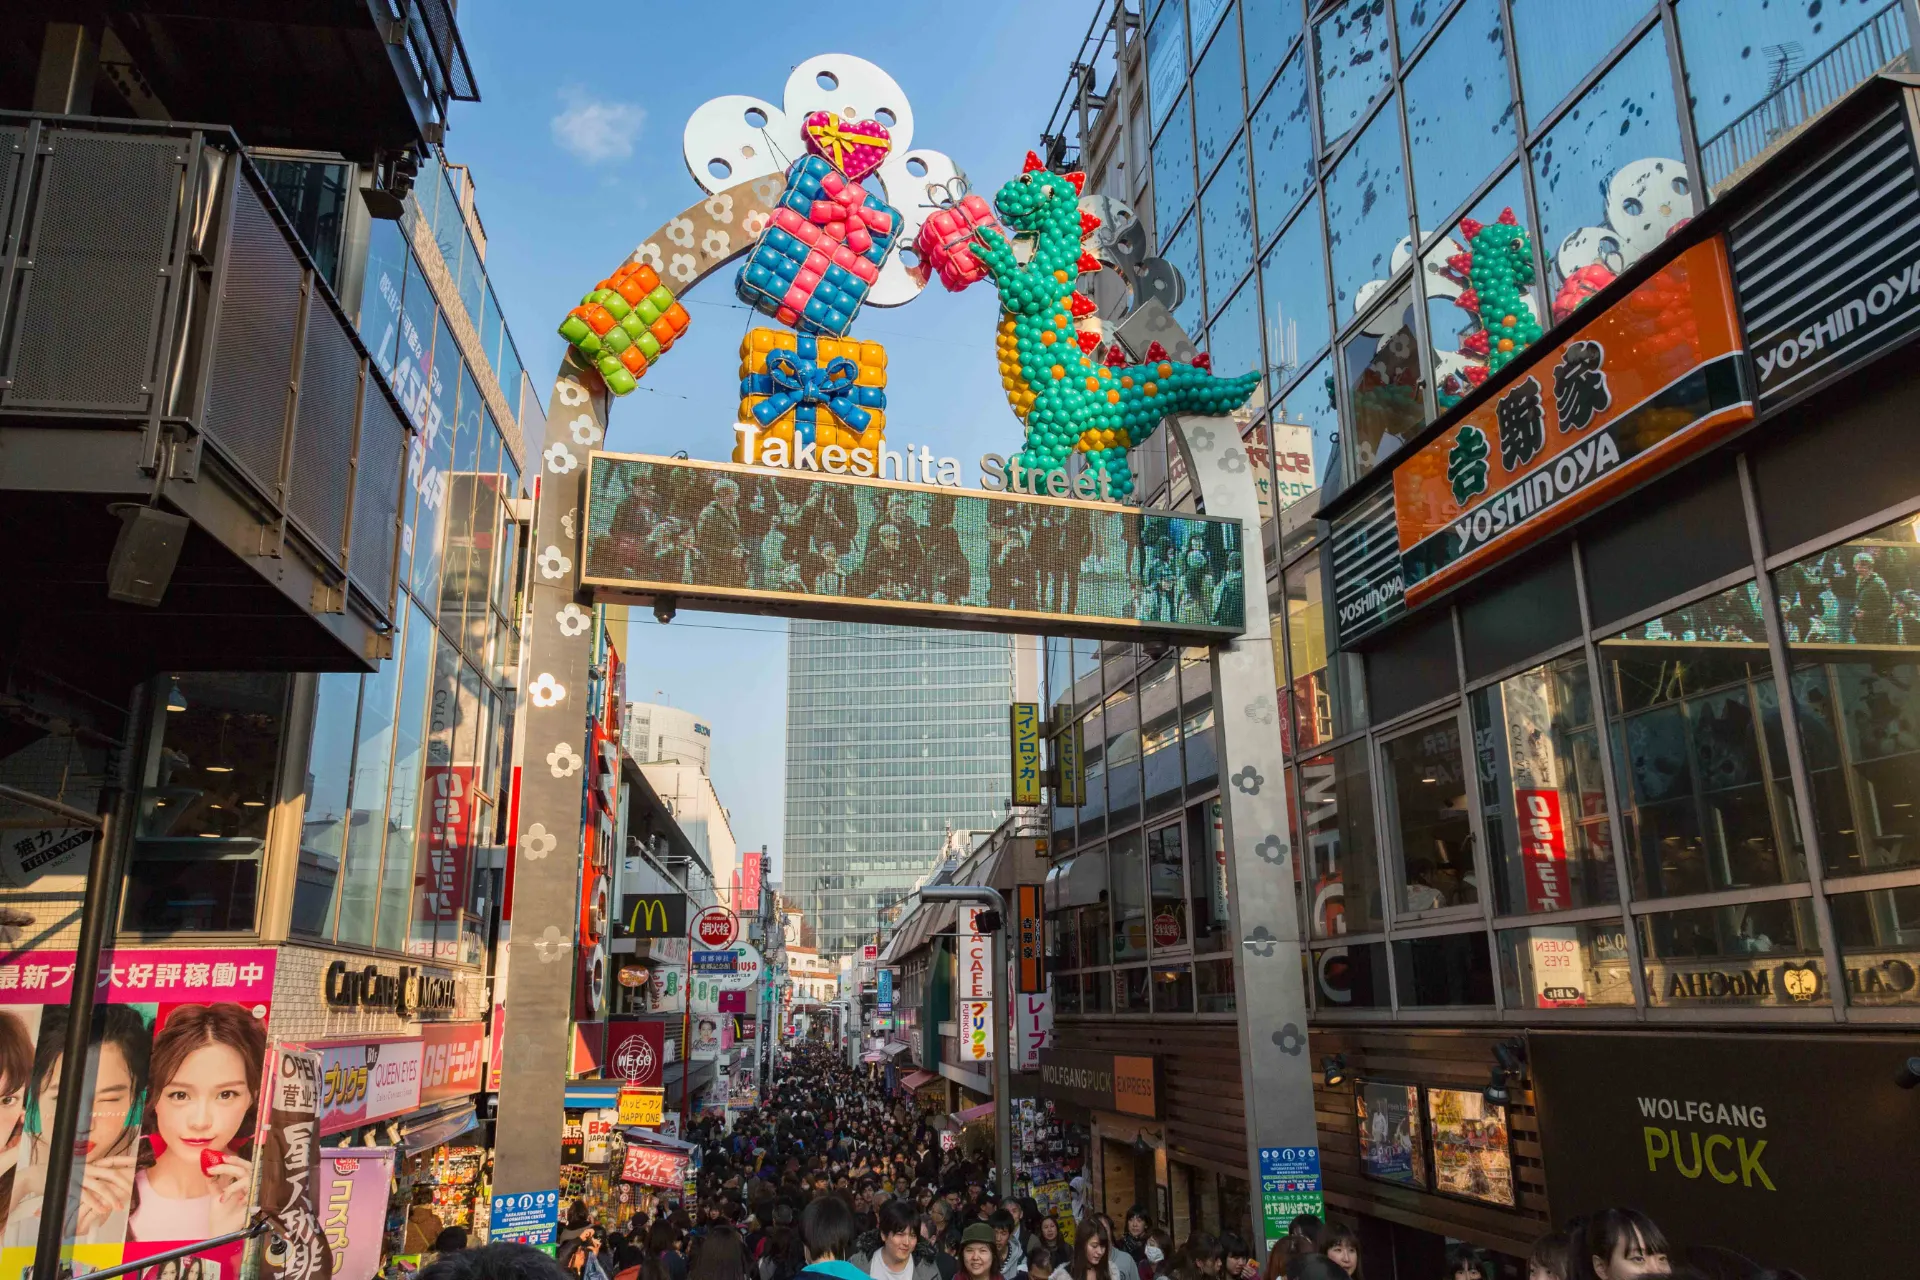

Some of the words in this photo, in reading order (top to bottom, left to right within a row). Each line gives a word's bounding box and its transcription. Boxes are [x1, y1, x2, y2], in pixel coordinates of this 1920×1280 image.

[1446, 340, 1611, 506] 吉野家
[733, 422, 961, 487] Takeshita
[980, 452, 1116, 503] Street
[1455, 432, 1620, 554] YOSHINOYA
[1338, 574, 1403, 627] YOSHINOYA
[1018, 705, 1037, 792] コインロッカー
[1019, 794, 1038, 804] 3F
[747, 857, 757, 905] DAISO
[701, 922, 730, 936] 消火栓
[1023, 918, 1033, 959] 吉野家
[0, 962, 264, 990] 最新プ大好評稼働中
[969, 948, 984, 997] CAFE
[962, 1003, 970, 1045] PURIKURA
[972, 1002, 987, 1060] プリクラ
[1028, 995, 1046, 1049] レープ
[375, 1062, 400, 1088] QUEEN
[401, 1060, 418, 1082] EYES
[422, 1040, 481, 1089] OSドラッグ
[1041, 1065, 1087, 1089] WOLFGANG
[1087, 1070, 1112, 1093] PUCK
[1117, 1076, 1152, 1097] EXPRESS
[621, 1113, 643, 1122] HAPPY
[645, 1113, 660, 1123] ONE
[622, 1099, 661, 1109] ハッピーワン
[1637, 1096, 1768, 1129] WOLFGANG
[562, 1125, 583, 1138] 東京
[588, 1121, 611, 1135] 日本
[623, 1170, 683, 1186] SQUEEZE
[1643, 1126, 1777, 1191] PUCK
